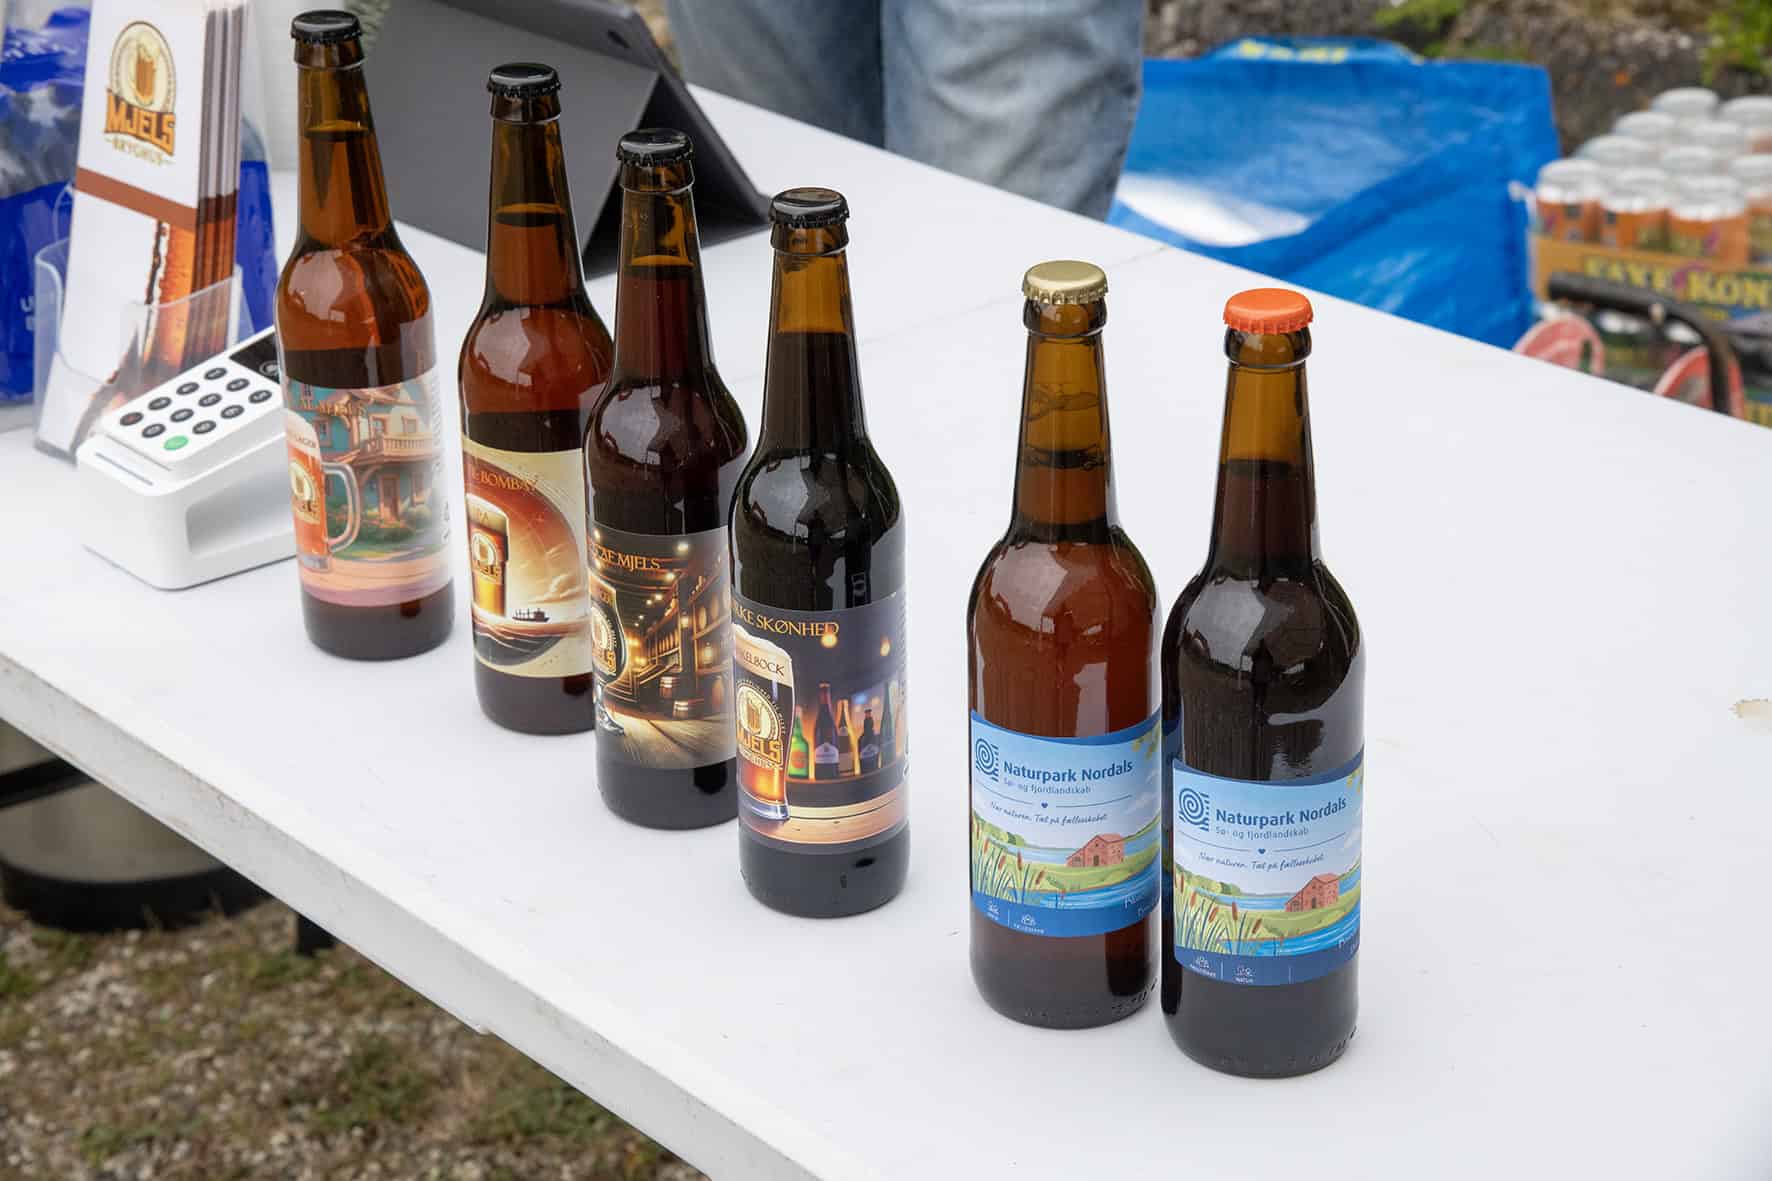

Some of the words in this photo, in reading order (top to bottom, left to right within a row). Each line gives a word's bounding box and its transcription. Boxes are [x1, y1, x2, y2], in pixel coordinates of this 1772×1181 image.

[104, 88, 176, 156] MJELS
[617, 552, 662, 573] MJELS
[756, 613, 840, 637] SKØNHED
[1003, 760, 1077, 784] Naturpark
[1081, 759, 1134, 782] Nordals
[1216, 808, 1295, 829] Naturpark
[1299, 796, 1347, 822] Nordals
[1232, 830, 1245, 840] og
[1247, 827, 1310, 841] fjordlandskab
